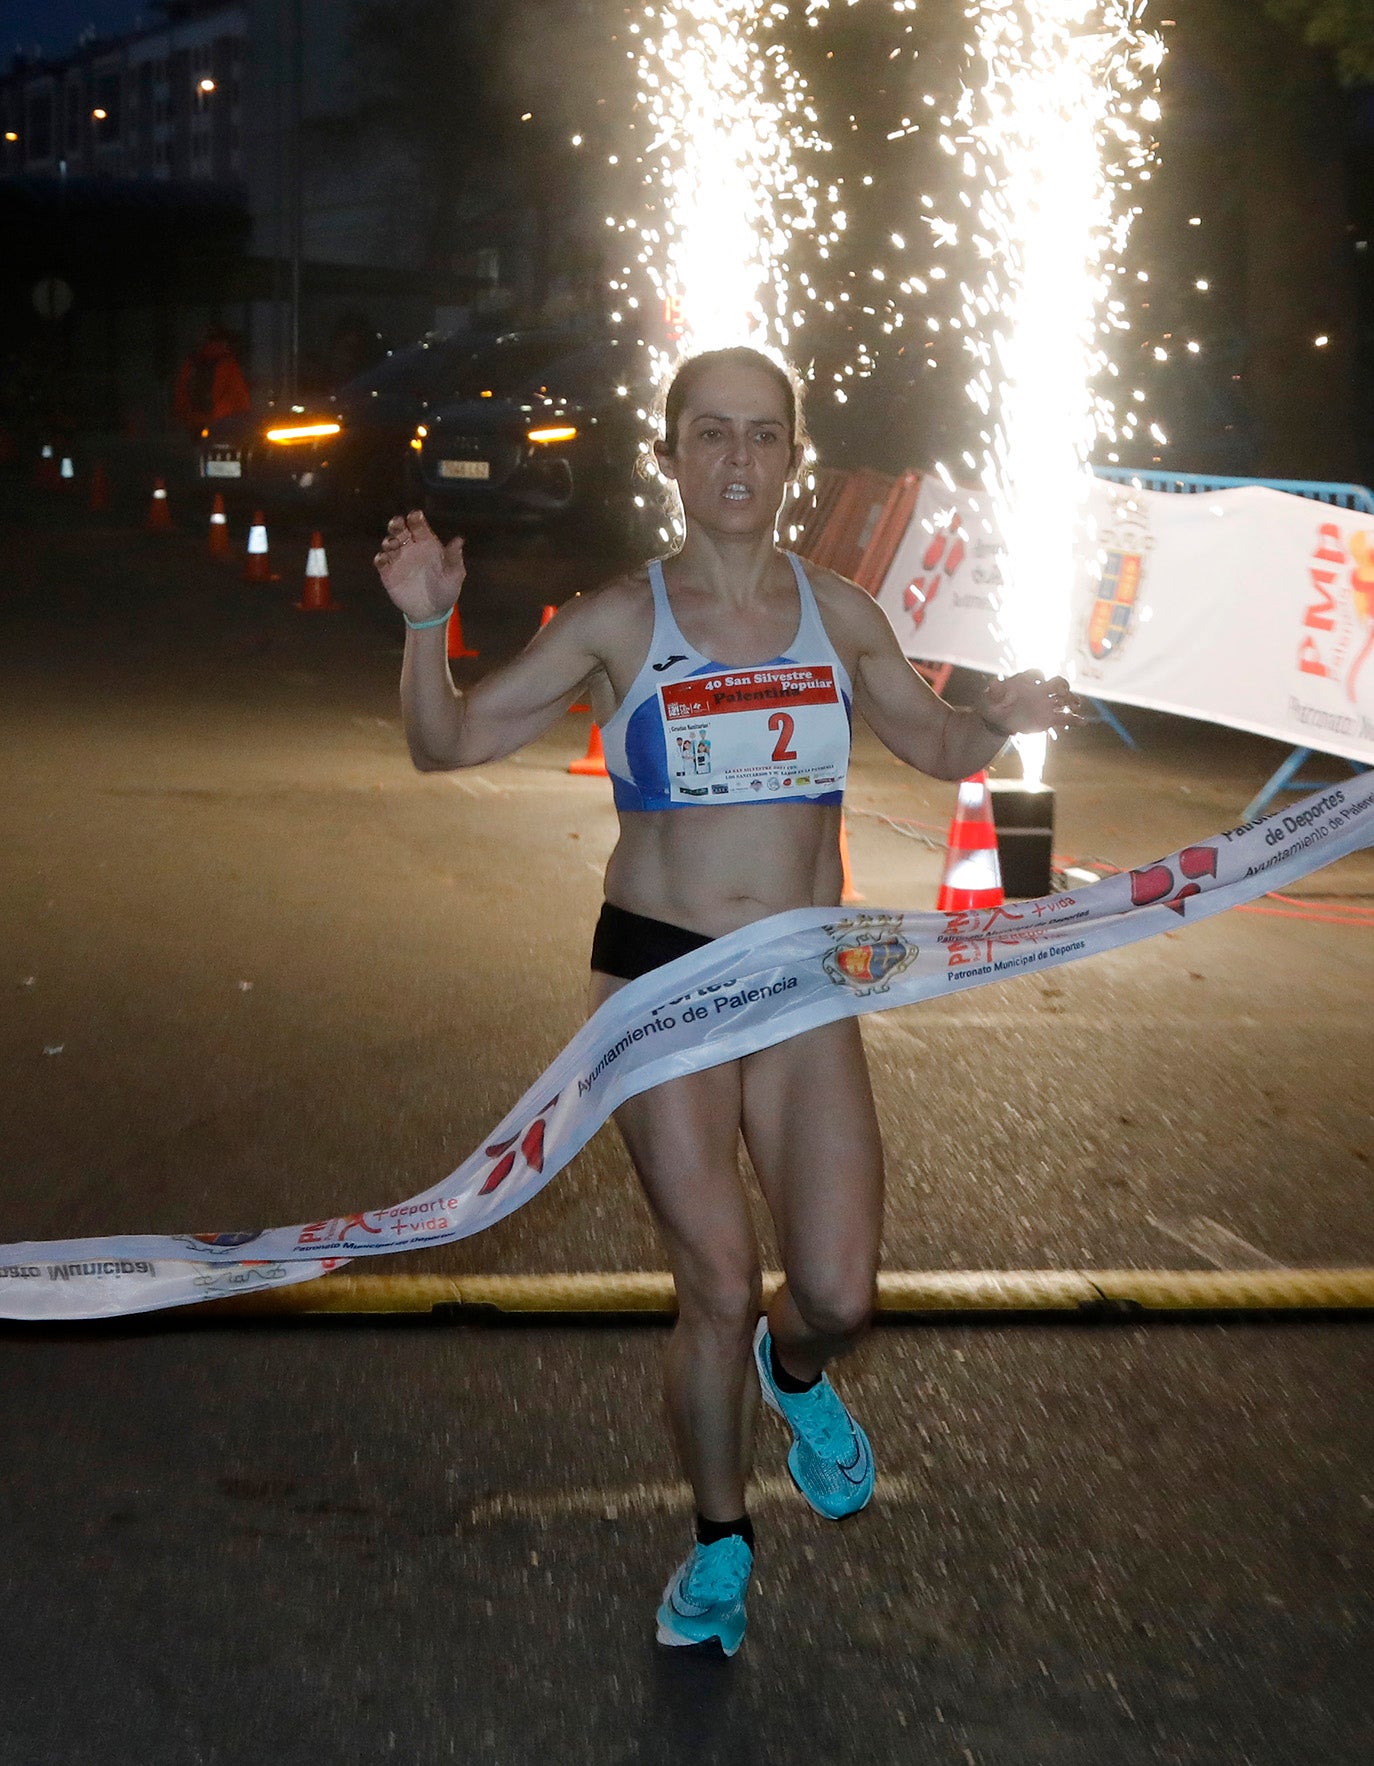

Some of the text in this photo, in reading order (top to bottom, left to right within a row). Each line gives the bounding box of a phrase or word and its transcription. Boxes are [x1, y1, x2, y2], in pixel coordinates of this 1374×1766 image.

[704, 671, 813, 691] 40 San Silvestre
[781, 679, 833, 691] Popular
[768, 712, 797, 762] 2
[1266, 826, 1285, 846] de
[1282, 790, 1346, 834] Deportes
[1245, 825, 1329, 878] Ayuntamiento
[1329, 816, 1345, 831] de
[947, 940, 1086, 981] Patronato Municipal de Deportes
[577, 1016, 676, 1097] Ayuntamiento
[682, 1003, 708, 1023] de
[713, 976, 798, 1013] Palencia
